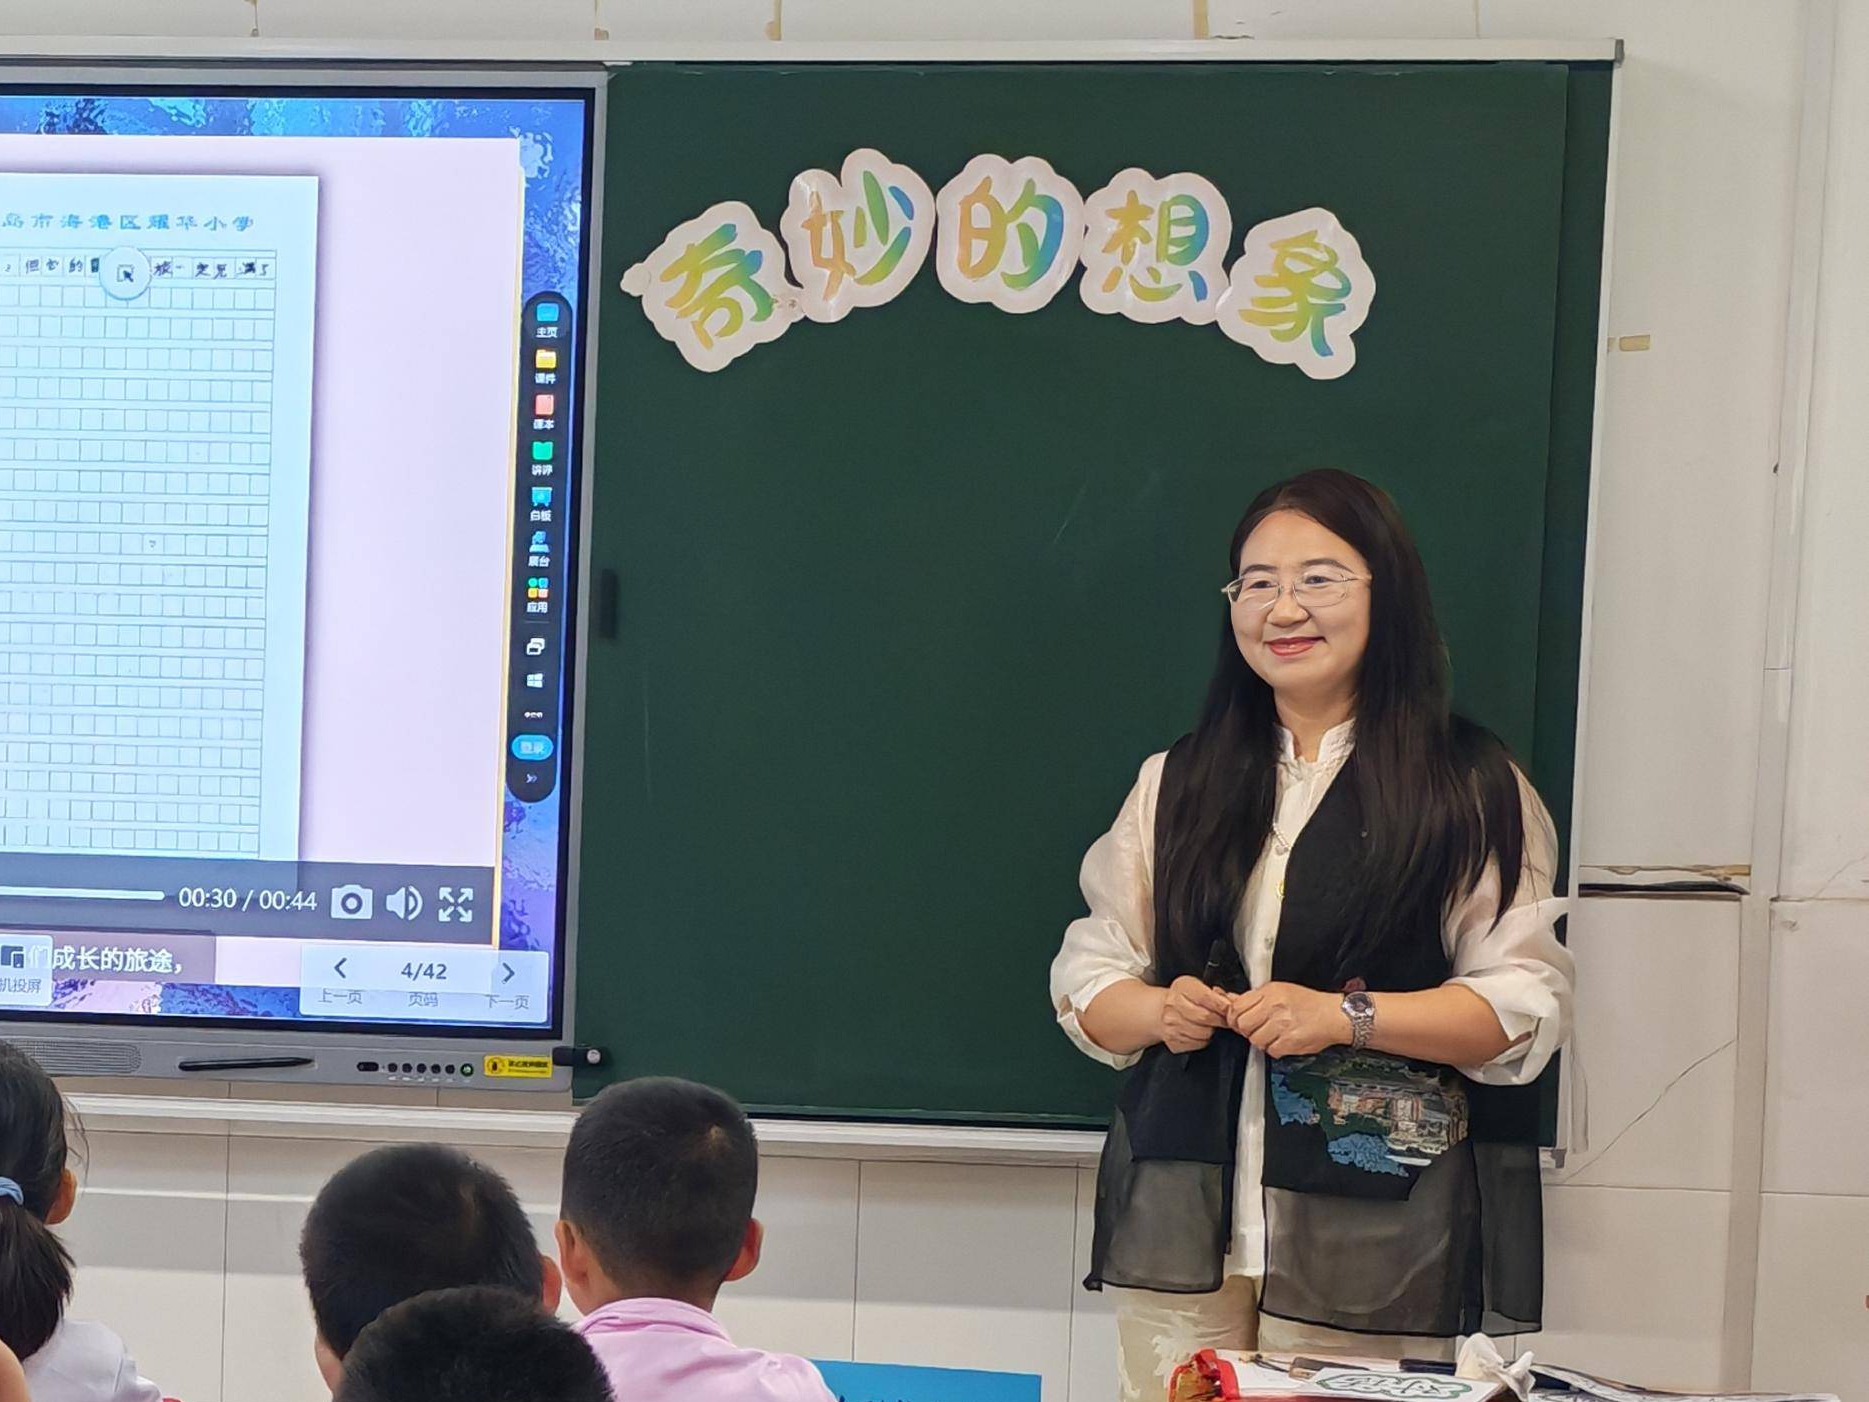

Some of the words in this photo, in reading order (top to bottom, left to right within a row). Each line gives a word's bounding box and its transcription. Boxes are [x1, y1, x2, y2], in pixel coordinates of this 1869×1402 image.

[658, 167, 1352, 358] 奇妙的想象
[535, 326, 559, 339] 主页
[534, 372, 557, 385] 课件
[532, 418, 555, 430] 课本
[529, 510, 552, 522] 白板
[528, 555, 551, 568] 展台
[526, 602, 549, 614] 应用
[178, 887, 238, 909] 00:30
[258, 889, 318, 911] 00:44
[401, 962, 448, 982] 4/42
[317, 988, 363, 1006] 上一页
[407, 990, 439, 1009] 页码
[484, 994, 530, 1011] 下一页
